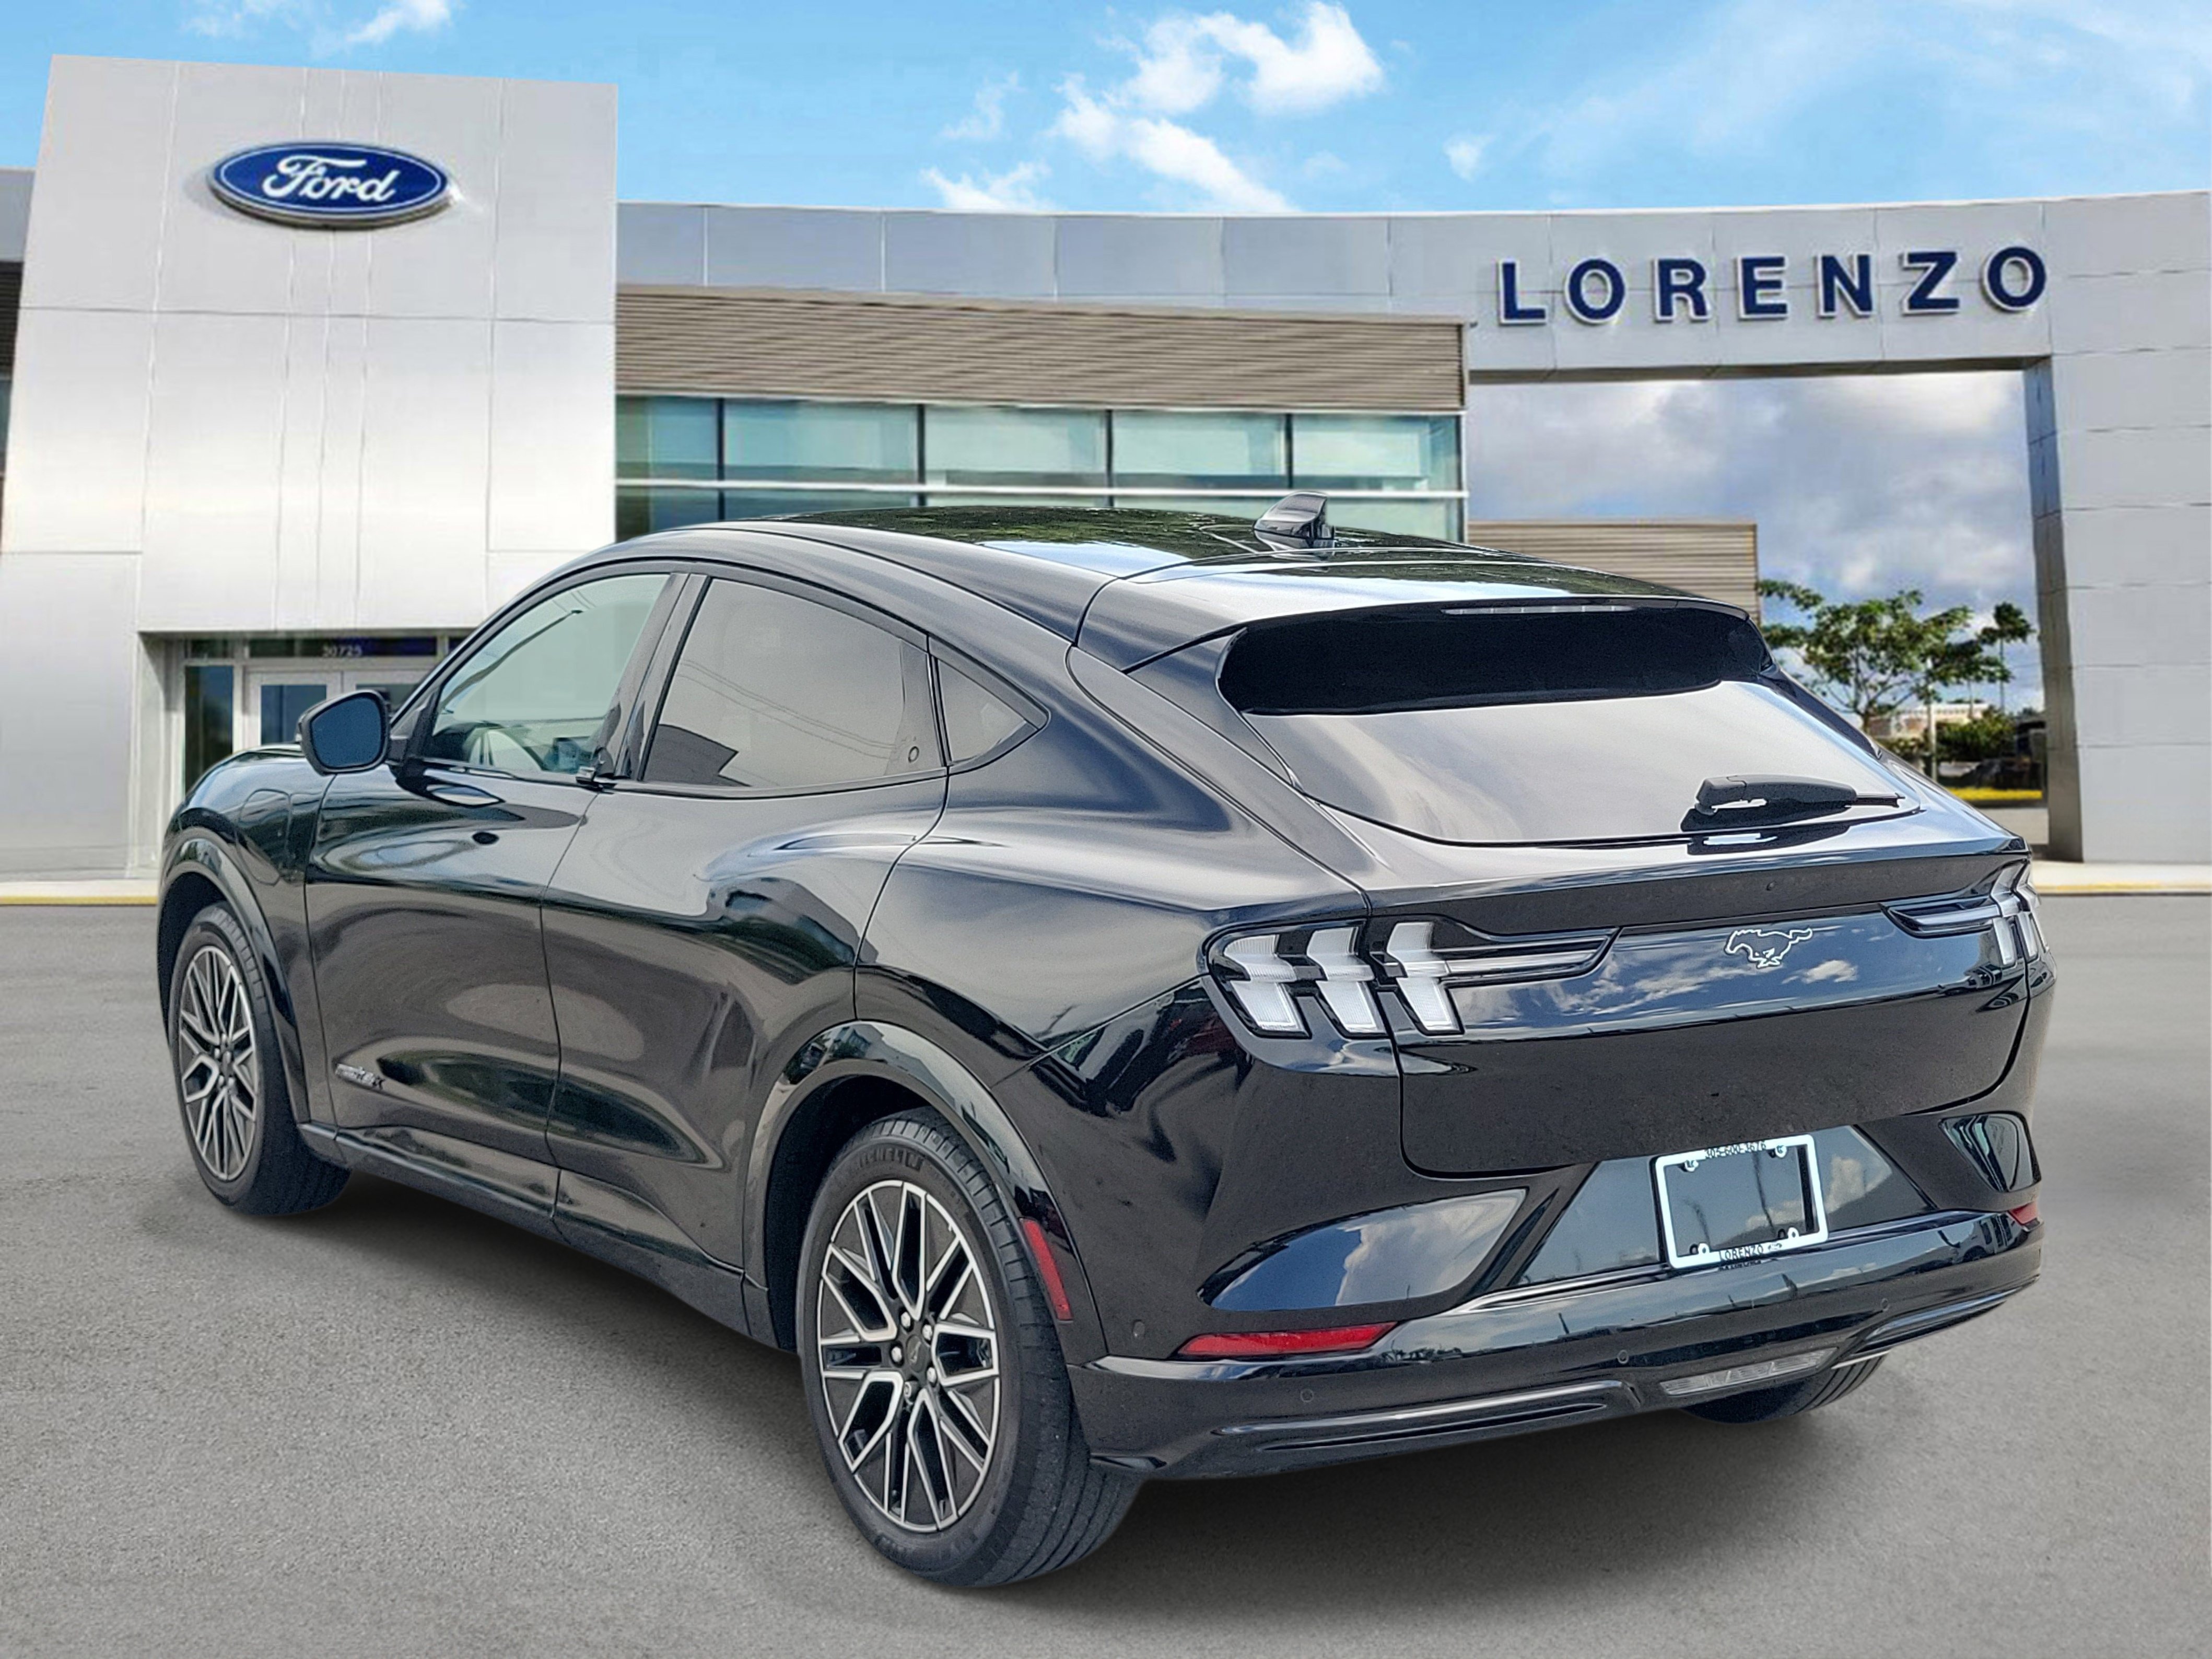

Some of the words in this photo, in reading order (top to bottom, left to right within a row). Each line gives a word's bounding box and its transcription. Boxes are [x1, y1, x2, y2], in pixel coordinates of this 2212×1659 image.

[263, 155, 401, 202] Ford
[1498, 244, 2047, 323] LORENZO
[1718, 1243, 1764, 1262] LORENZO
